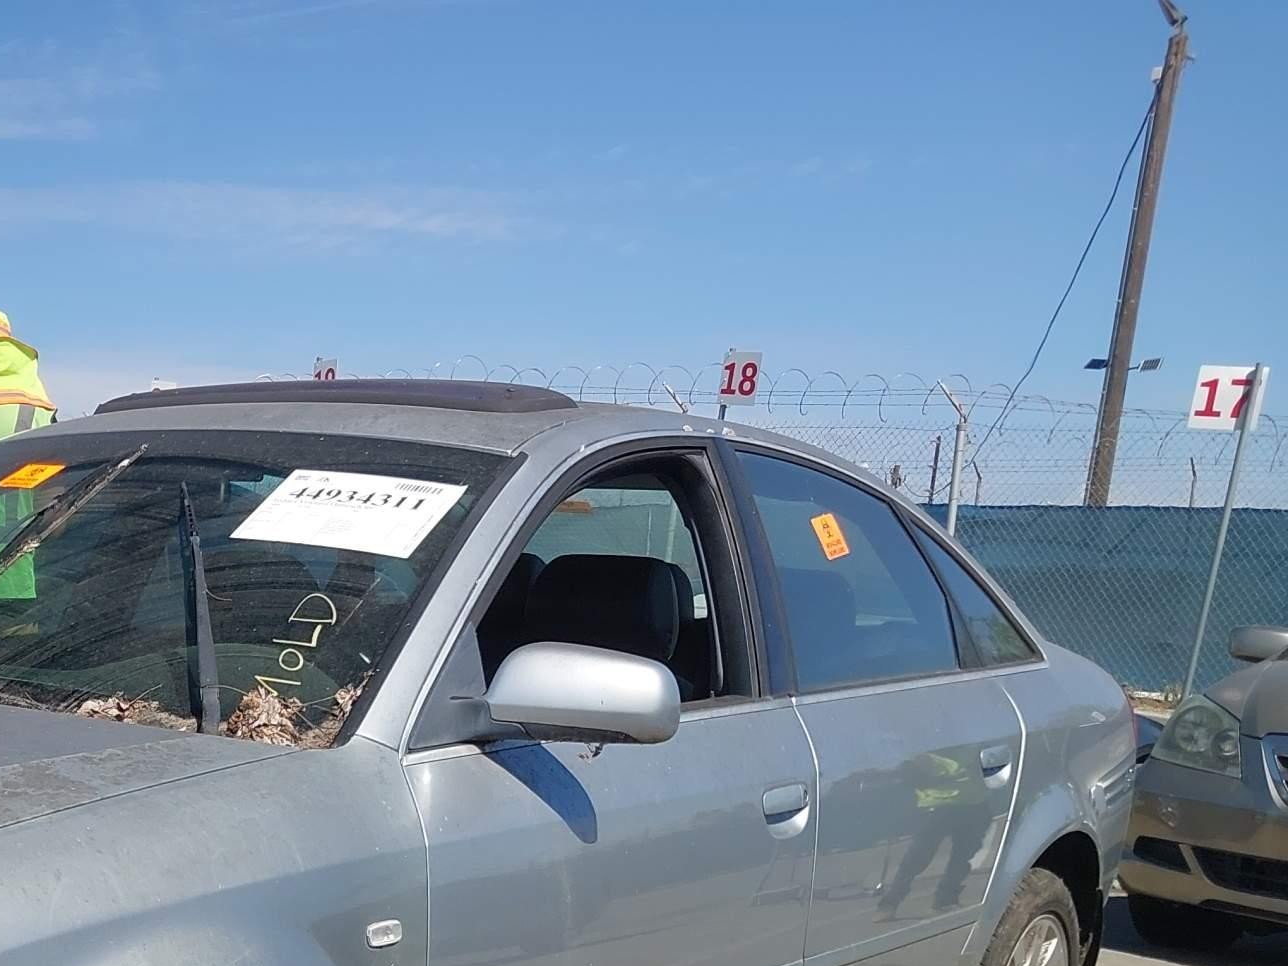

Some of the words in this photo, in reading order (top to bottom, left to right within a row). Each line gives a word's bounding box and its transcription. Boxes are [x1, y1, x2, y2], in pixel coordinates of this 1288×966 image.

[720, 362, 758, 396] 18
[1194, 379, 1253, 418] 17
[288, 486, 426, 510] 44934311
